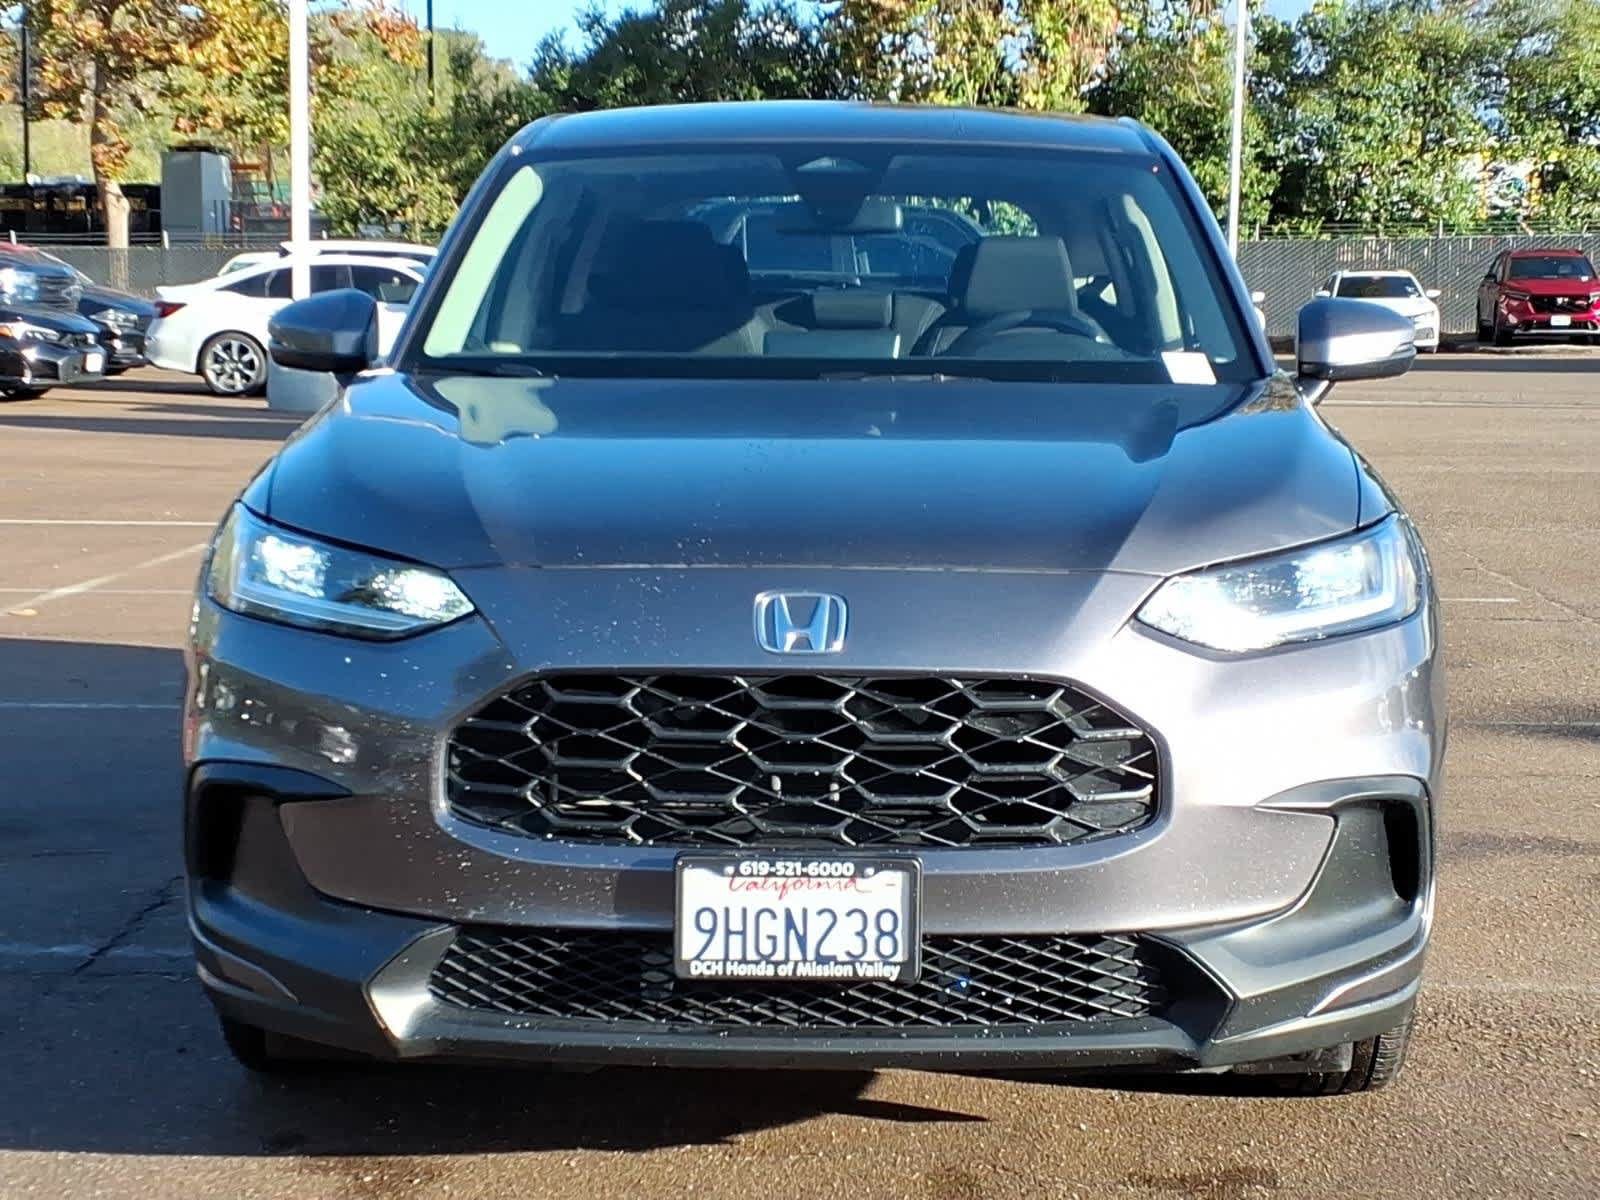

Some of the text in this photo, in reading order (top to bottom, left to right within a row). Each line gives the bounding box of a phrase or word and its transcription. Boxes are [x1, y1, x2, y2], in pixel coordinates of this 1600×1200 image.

[739, 861, 855, 877] 619-521-6000
[728, 873, 872, 900] California
[694, 906, 900, 961] 9HGN238
[689, 961, 901, 981] DCH Honda of Mission Valley
